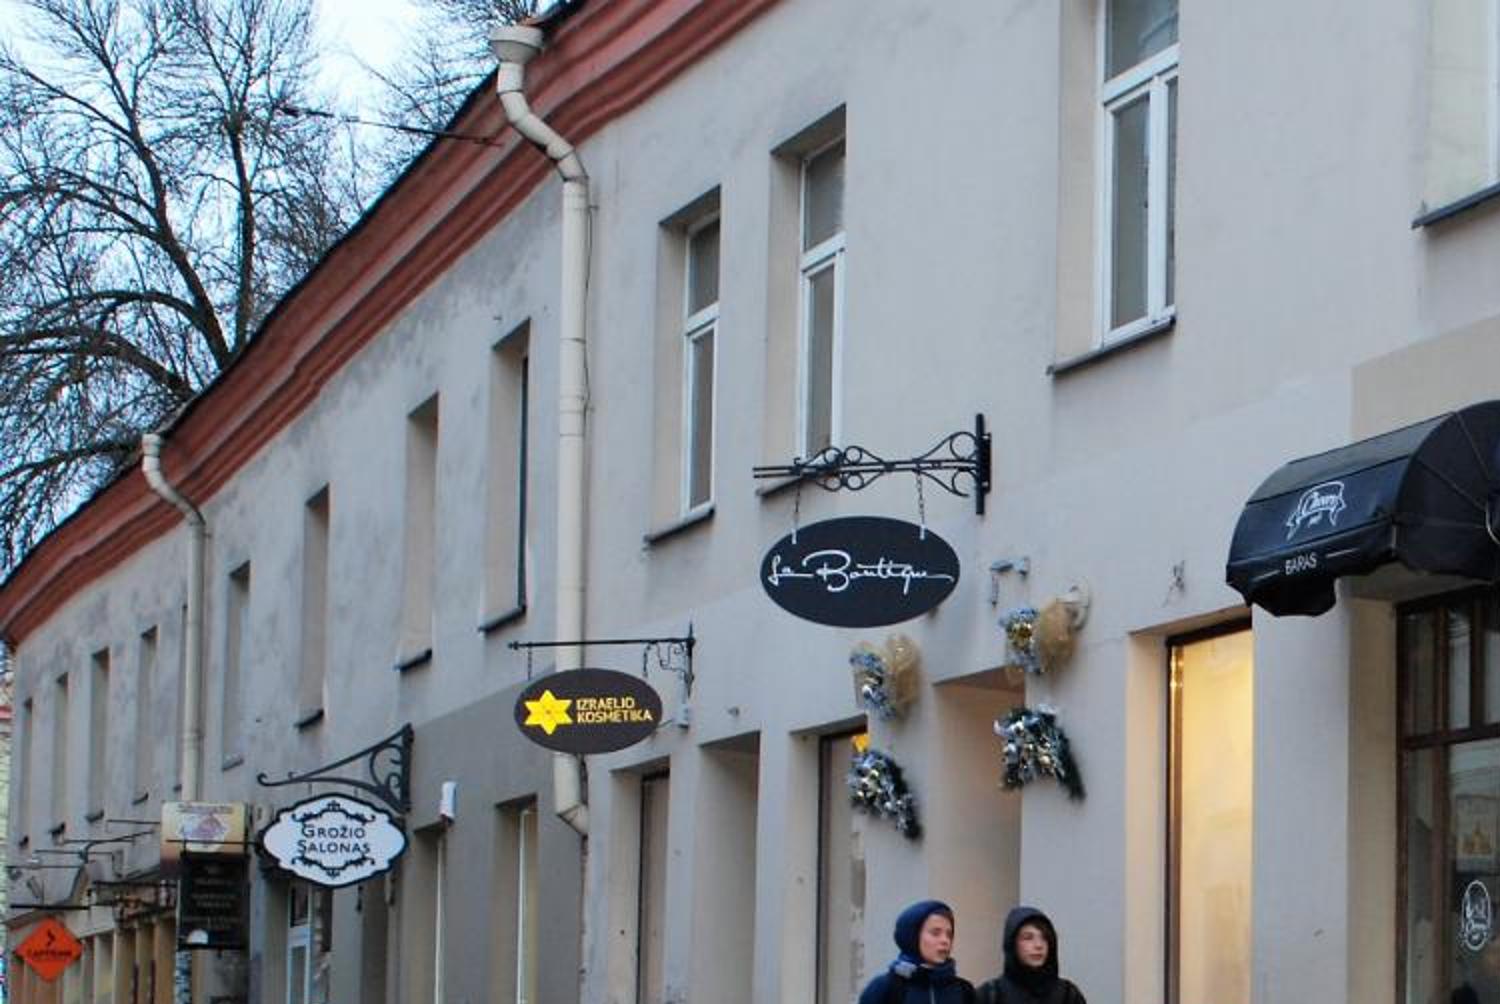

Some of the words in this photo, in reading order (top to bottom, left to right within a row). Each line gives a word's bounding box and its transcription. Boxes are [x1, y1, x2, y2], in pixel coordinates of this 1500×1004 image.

[768, 555, 814, 587] La
[1285, 551, 1318, 576] BARAS
[575, 697, 635, 711] IZRAELIO
[576, 709, 653, 723] KOSMETIKA
[301, 822, 366, 839] GROŽIO
[298, 839, 371, 854] SALONAS
